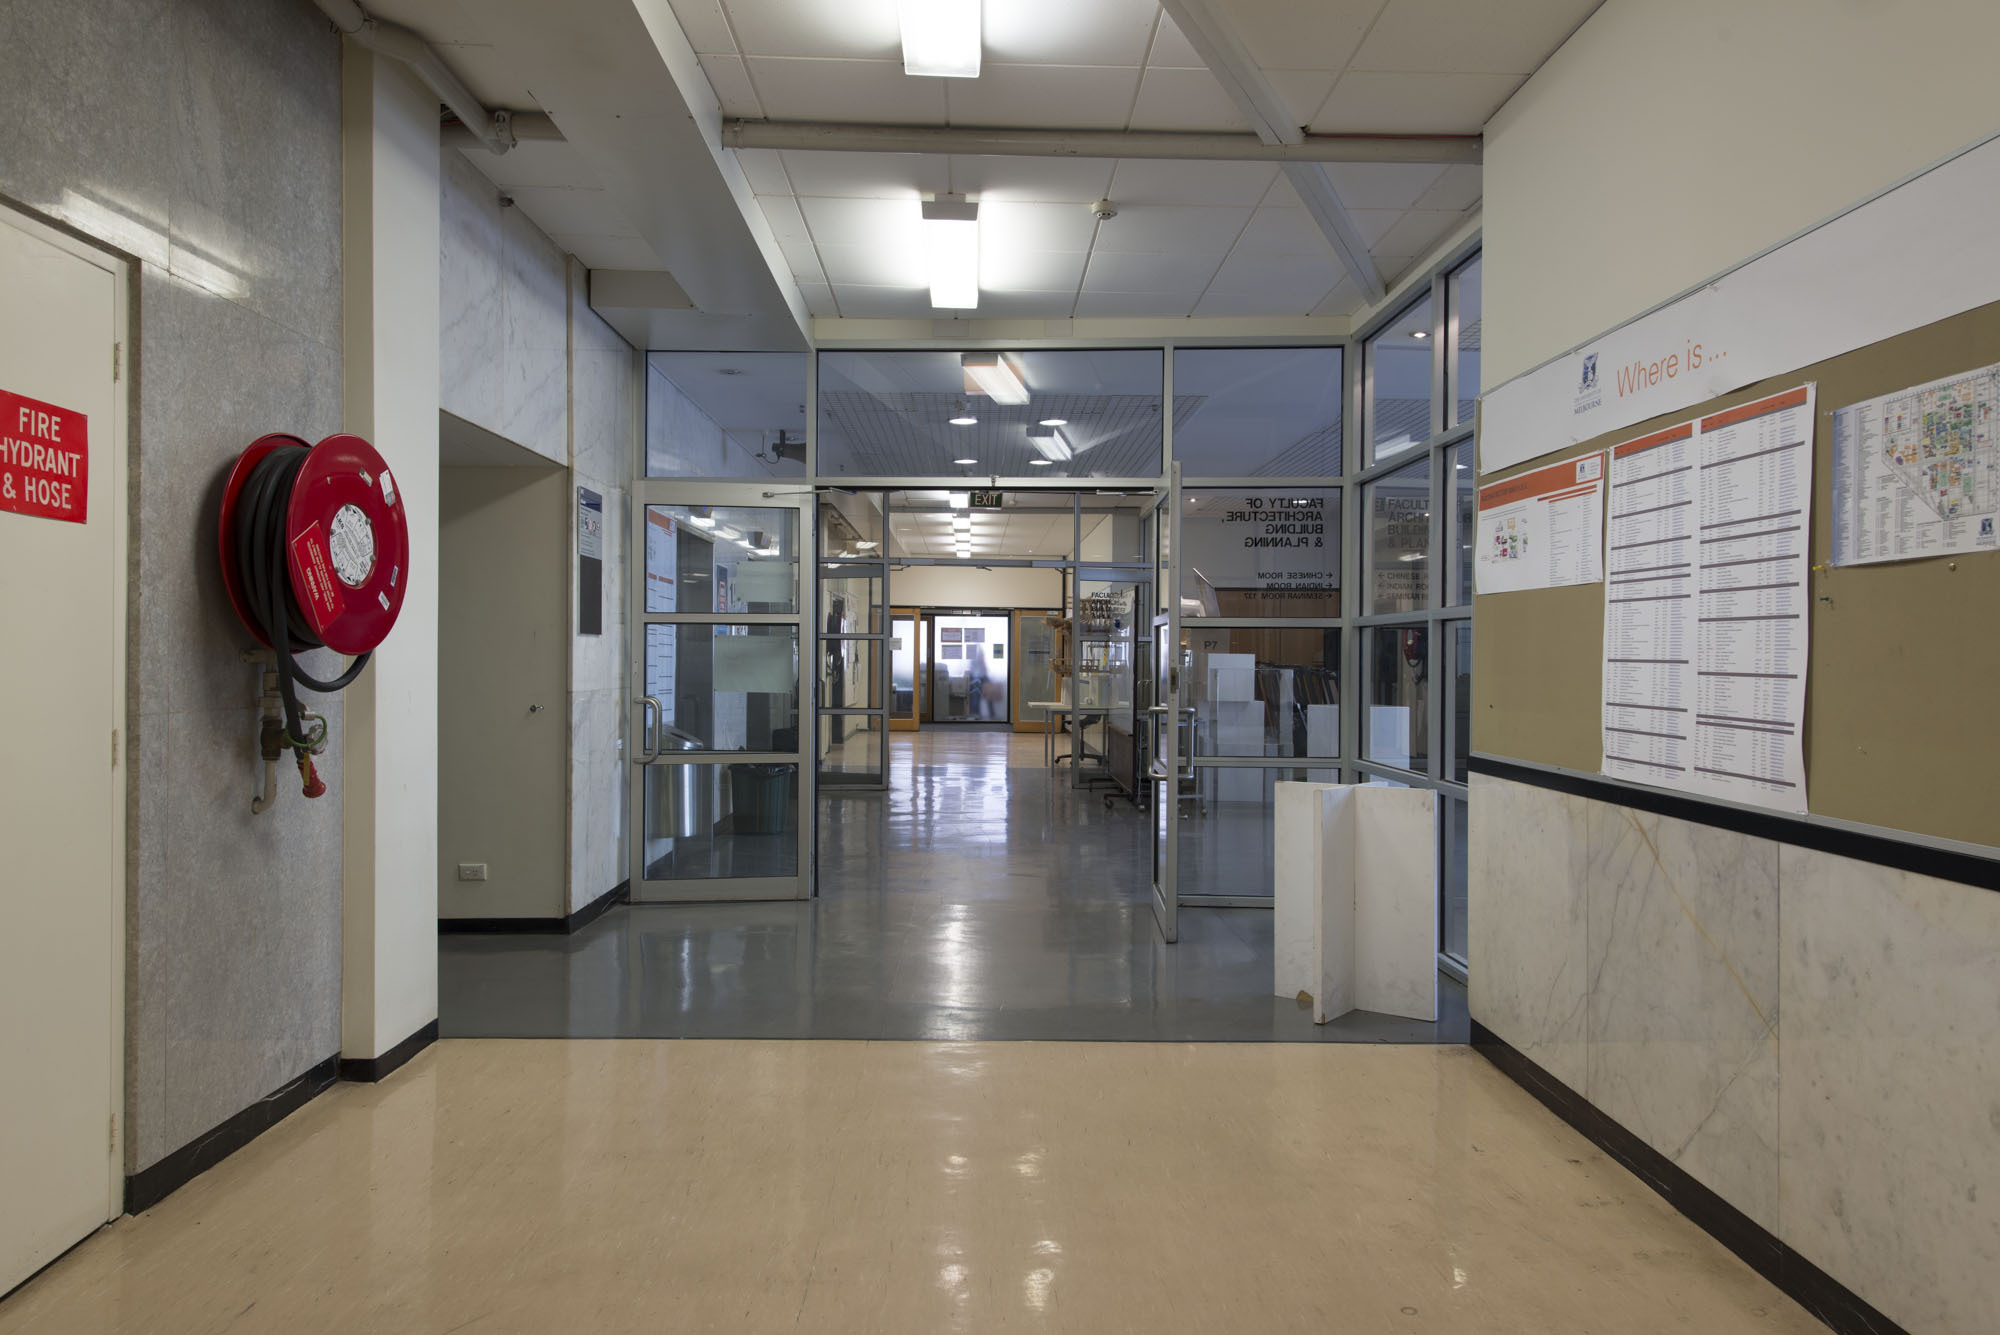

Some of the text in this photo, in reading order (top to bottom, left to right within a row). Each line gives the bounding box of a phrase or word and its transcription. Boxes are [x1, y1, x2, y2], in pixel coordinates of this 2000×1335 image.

[1617, 354, 1679, 398] Where
[20, 407, 61, 442] FIRE
[0, 437, 80, 478] HYDRANT
[3, 472, 72, 509] & HOSE
[975, 494, 997, 505] EXIT
[1204, 640, 1218, 650] P7
